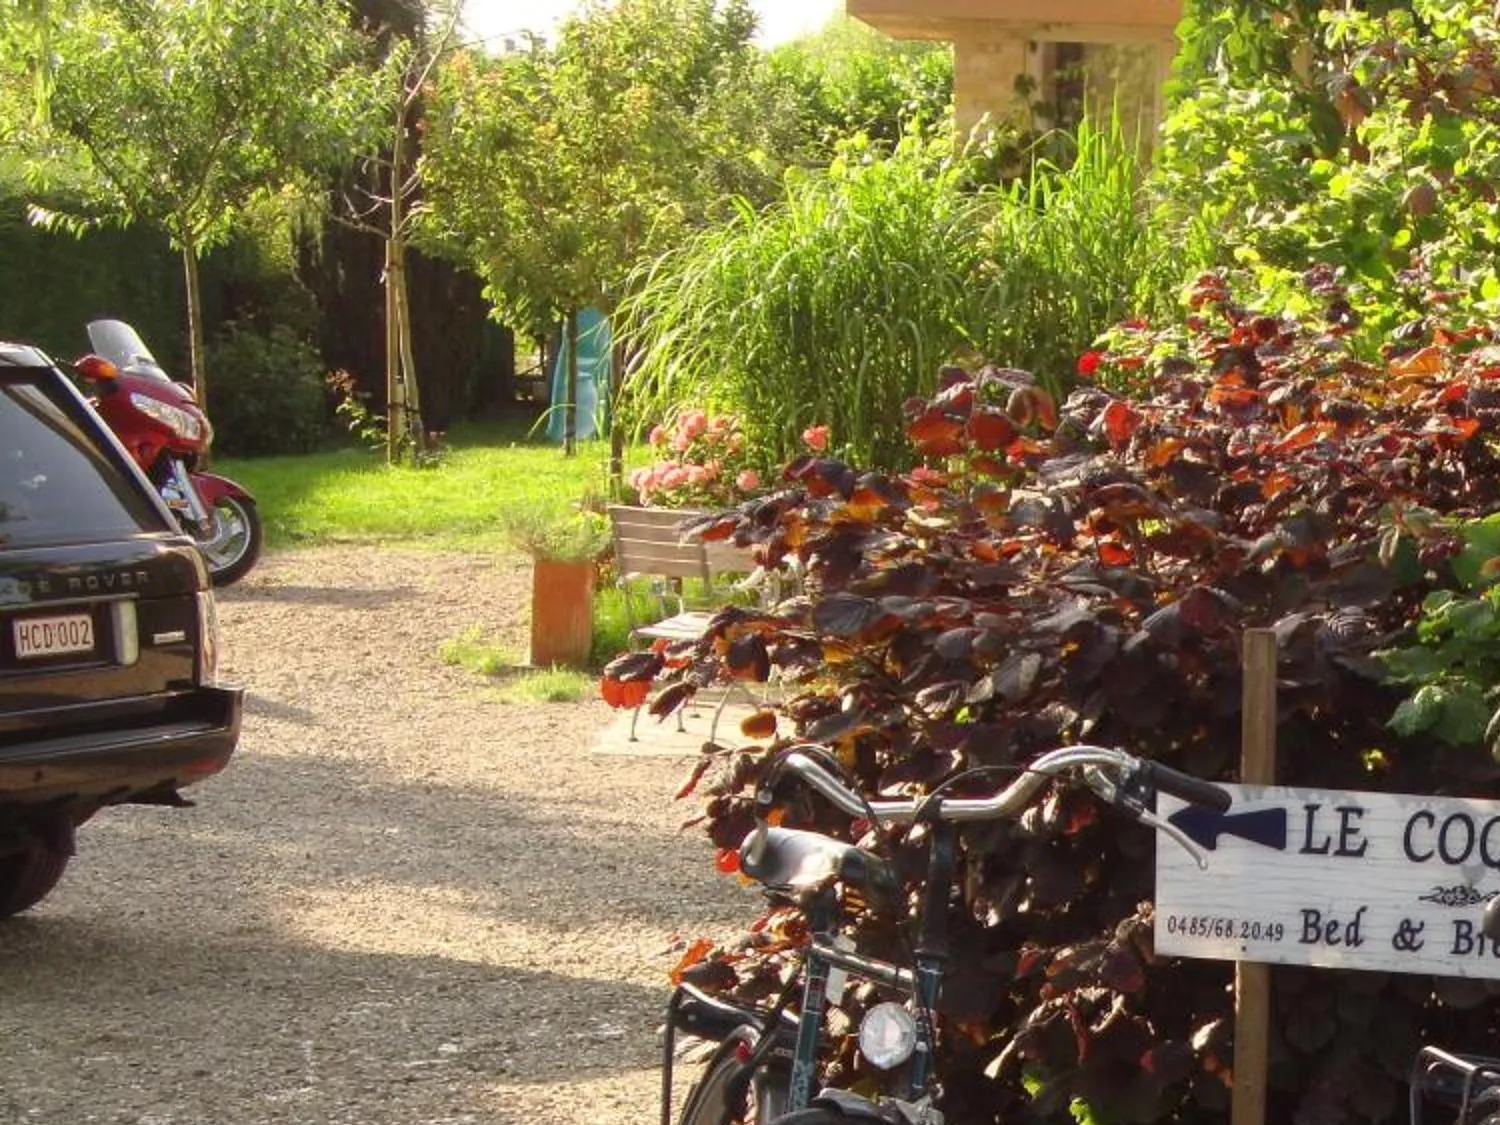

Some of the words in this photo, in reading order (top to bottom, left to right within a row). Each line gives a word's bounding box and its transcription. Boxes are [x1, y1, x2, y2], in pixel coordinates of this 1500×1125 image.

[1298, 803, 1368, 858] LE
[1167, 915, 1285, 942] 0485/68.20.49
[1298, 906, 1368, 948] Bed
[1391, 918, 1425, 951] &
